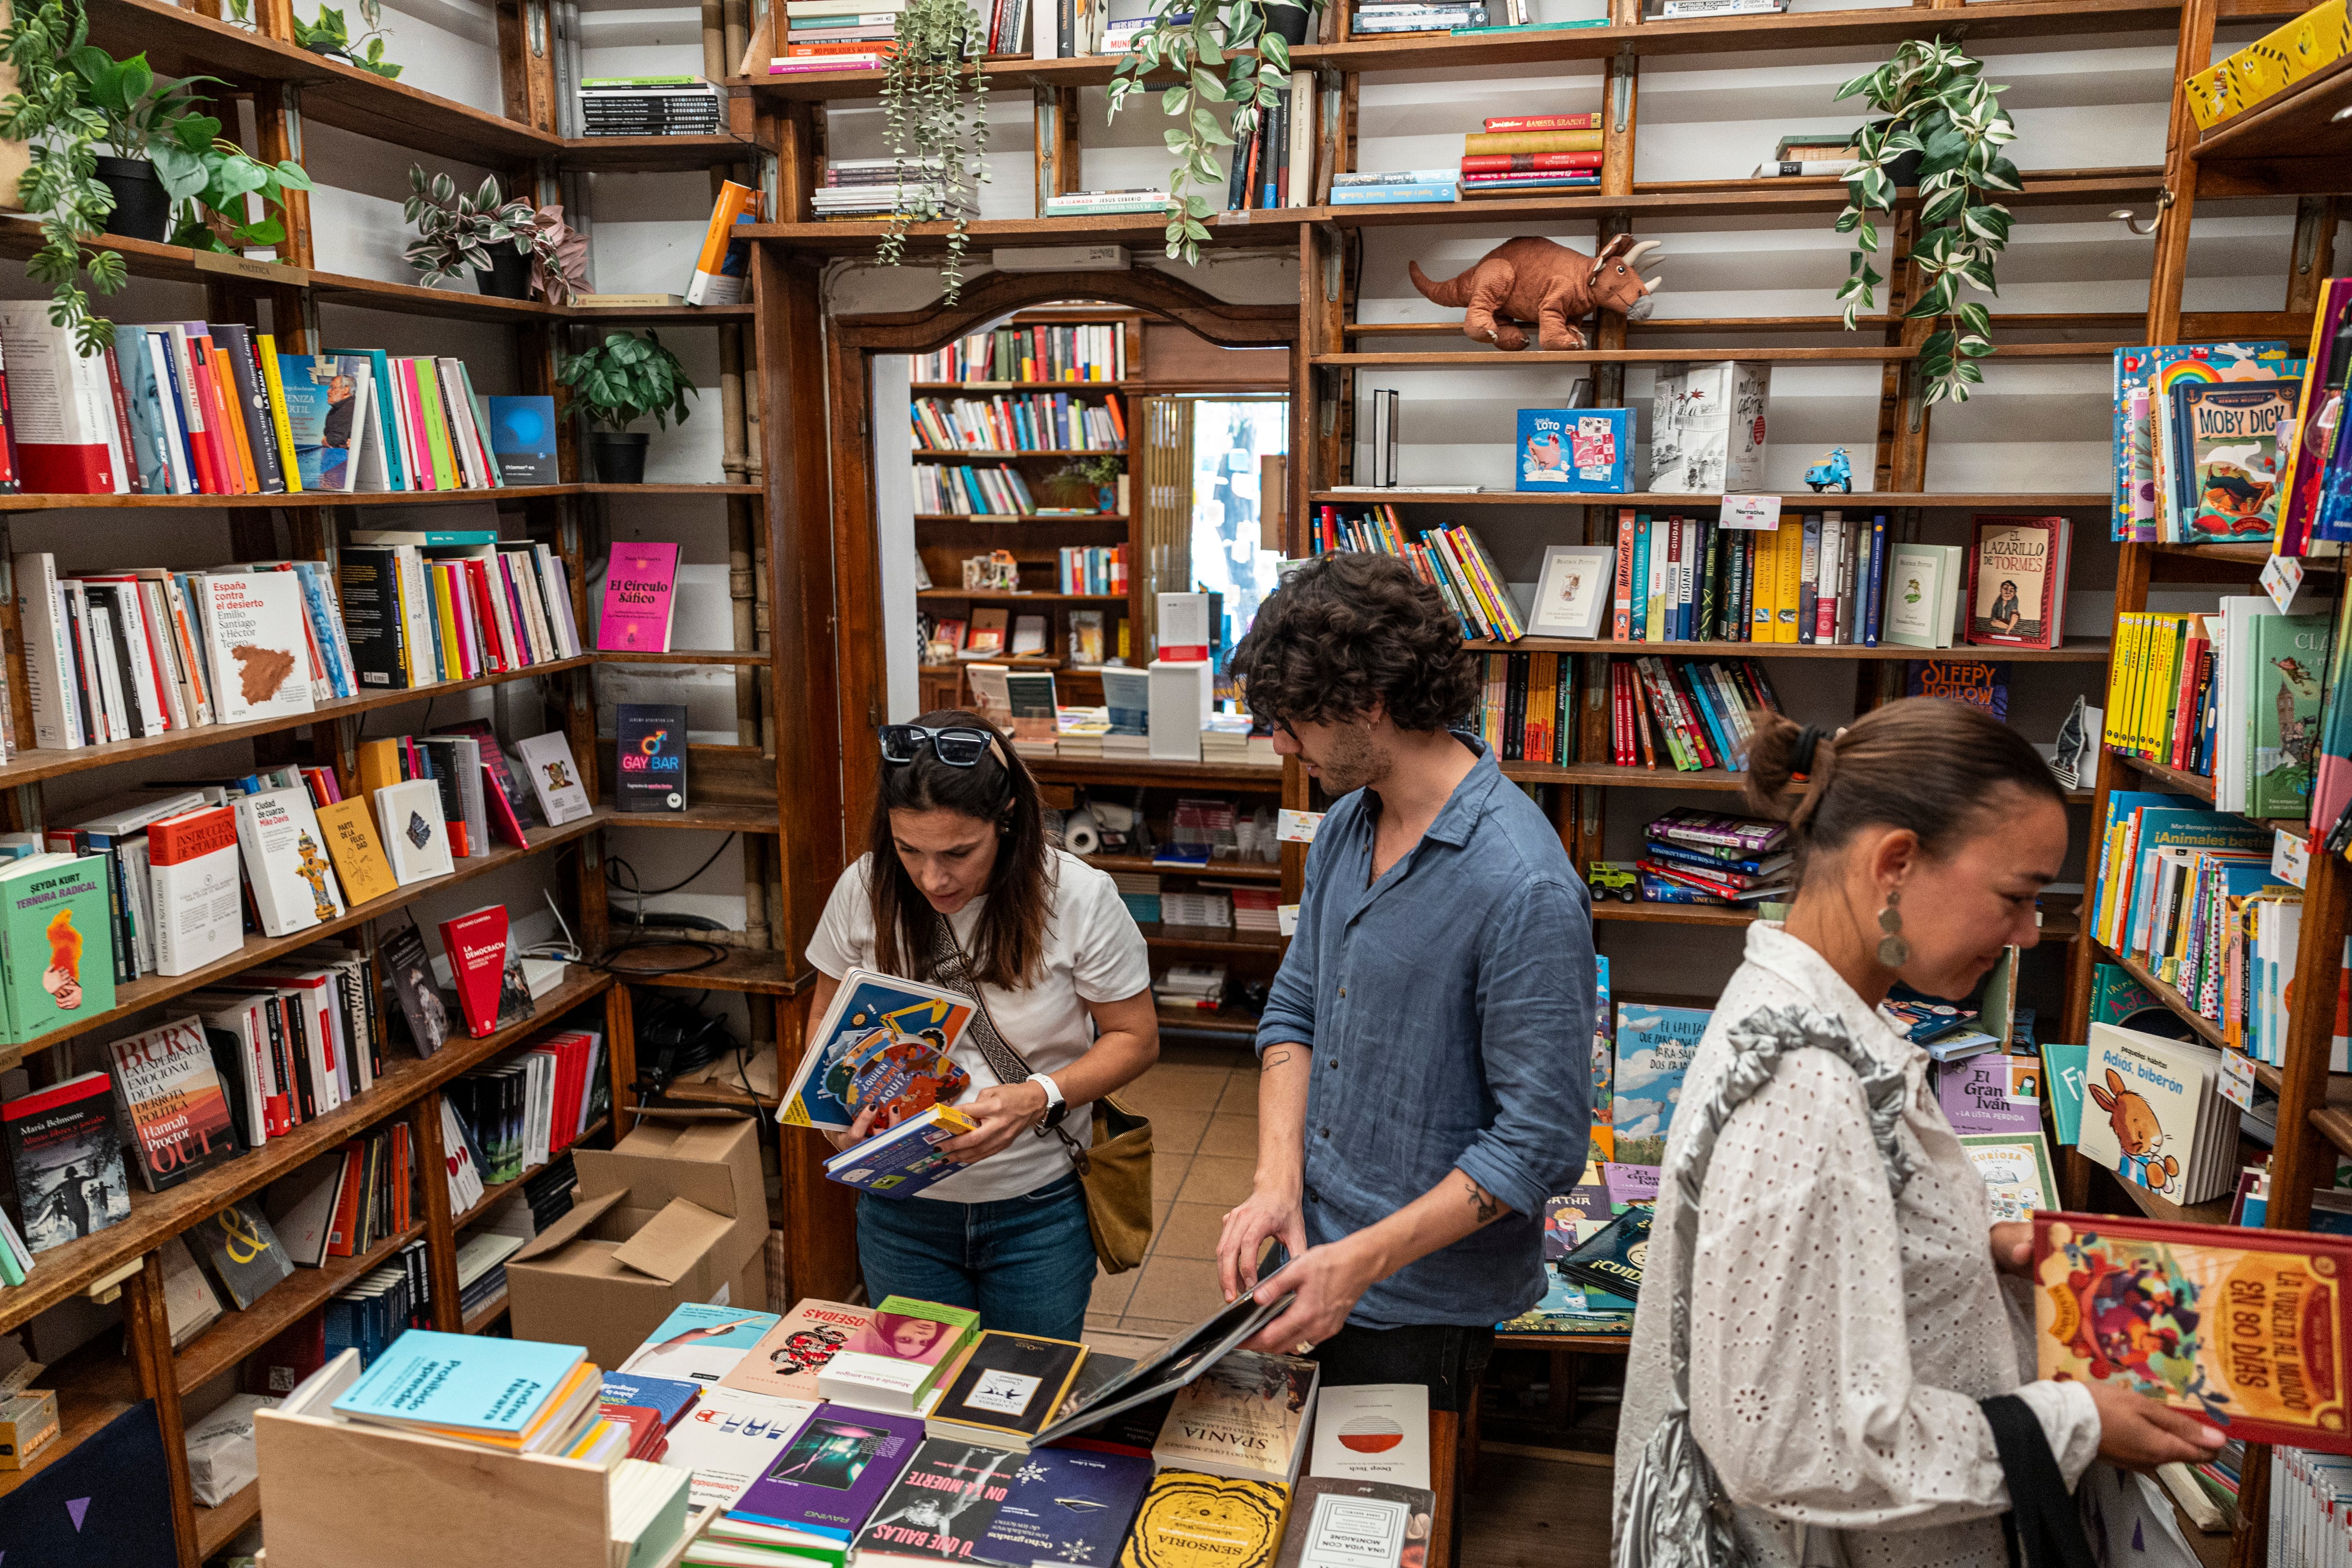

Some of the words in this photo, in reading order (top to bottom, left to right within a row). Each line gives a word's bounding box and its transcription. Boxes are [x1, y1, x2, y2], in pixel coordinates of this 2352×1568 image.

[1526, 119, 1556, 127] GANGSTA
[1557, 118, 1586, 126] GRANNY
[238, 263, 270, 275] POLÍTICA
[270, 353, 280, 387] ESPAÑA
[257, 369, 268, 397] TRAMA
[263, 397, 270, 409] LA
[277, 393, 286, 414] REID
[1536, 422, 1560, 431] LOTO
[2199, 406, 2244, 435] MOBY
[2249, 405, 2285, 434] DICK
[281, 416, 293, 456] MICHAEL
[2009, 531, 2021, 541] EL
[1983, 541, 2045, 557] LAZARILLO
[1619, 540, 1630, 587] HEARTSTOPPER
[1706, 548, 1716, 576] FRANKENSTEIN
[1733, 552, 1742, 573] RETRATO
[1984, 556, 1994, 565] DE
[1994, 557, 2043, 573] TORMES
[214, 581, 246, 592] España
[610, 580, 620, 591] El
[624, 579, 667, 592] Círculo
[1454, 571, 1471, 594] CORTOS
[215, 591, 244, 601] contra
[216, 602, 225, 611] el
[227, 600, 264, 609] desierto
[619, 592, 655, 604] Sáfico
[218, 611, 246, 620] Emilio
[1467, 595, 1484, 621] CUENTOS
[1633, 595, 1644, 620] ANA
[126, 611, 135, 630] BALDÍA
[219, 620, 256, 630] Santiago
[227, 629, 256, 637] Héctor
[222, 638, 248, 648] Tejero
[1921, 659, 1996, 687] SLEEPY
[622, 756, 649, 769] GAY
[652, 756, 678, 770] BAR
[254, 799, 276, 811] Ciudad
[266, 807, 285, 817] cuarzo
[259, 818, 272, 828] Mike
[274, 814, 289, 825] Davis
[337, 821, 354, 832] PARTE
[350, 834, 366, 844] FELICI
[357, 841, 368, 851] DAD
[59, 873, 80, 885] KURT
[16, 891, 57, 910] TERNURA
[59, 881, 97, 898] RADICAL
[465, 941, 506, 960] DEMOCRACIA
[1661, 1020, 1669, 1033] EL
[116, 1020, 203, 1071] BURN
[1639, 1032, 1653, 1043] QUE
[1677, 1037, 1692, 1047] UNA
[124, 1067, 140, 1078] LA
[141, 1044, 206, 1073] EXPERIENCIA
[2121, 1046, 2146, 1061] pequeños
[2146, 1055, 2168, 1069] hábitos
[128, 1061, 192, 1090] EMOCIONAL
[862, 1062, 890, 1092] ¿QUIÉN
[863, 1059, 906, 1103] DUERME
[1973, 1070, 1990, 1083] El
[2102, 1049, 2134, 1075] Adiós,
[2137, 1063, 2184, 1095] biberón
[131, 1088, 146, 1103] DE
[149, 1083, 167, 1095] LA
[879, 1072, 907, 1105] AQUÍ?
[1964, 1082, 2004, 1097] Gran
[135, 1088, 186, 1114] DERROTA
[1975, 1096, 2011, 1111] Iván
[139, 1100, 189, 1125] POLÍTICA
[1993, 1113, 2025, 1122] PERDIDA
[20, 1123, 45, 1136] María
[46, 1112, 85, 1128] Belmonte
[143, 1114, 189, 1140] Hannah
[147, 1128, 190, 1153] Proctor
[151, 1128, 212, 1173] OUT
[1971, 1152, 2022, 1162] CURIOSA
[2277, 1271, 2306, 1287] LA
[2230, 1280, 2266, 1308] EN
[802, 1308, 866, 1327] OSEIDAS
[2272, 1291, 2299, 1338] VUELTA
[2233, 1311, 2261, 1338] 80
[2273, 1342, 2298, 1357] AL
[2231, 1342, 2273, 1388] DÍAS
[391, 1361, 439, 1409] aprender
[407, 1360, 462, 1411] Prohibido
[2276, 1361, 2312, 1412] MUNDO
[483, 1378, 528, 1420] Navarra
[500, 1381, 541, 1422] Andreu
[1183, 1427, 1268, 1450] SPANIA
[699, 1492, 731, 1501] Zygmunt
[803, 1510, 850, 1524] RAVING
[872, 1524, 929, 1549] BAILAS
[926, 1534, 961, 1553] QUE
[987, 1531, 1025, 1543] grados
[1024, 1536, 1053, 1549] Ocho
[1158, 1534, 1243, 1555] SENSORIA
[1329, 1533, 1381, 1546] MONTAIGNE
